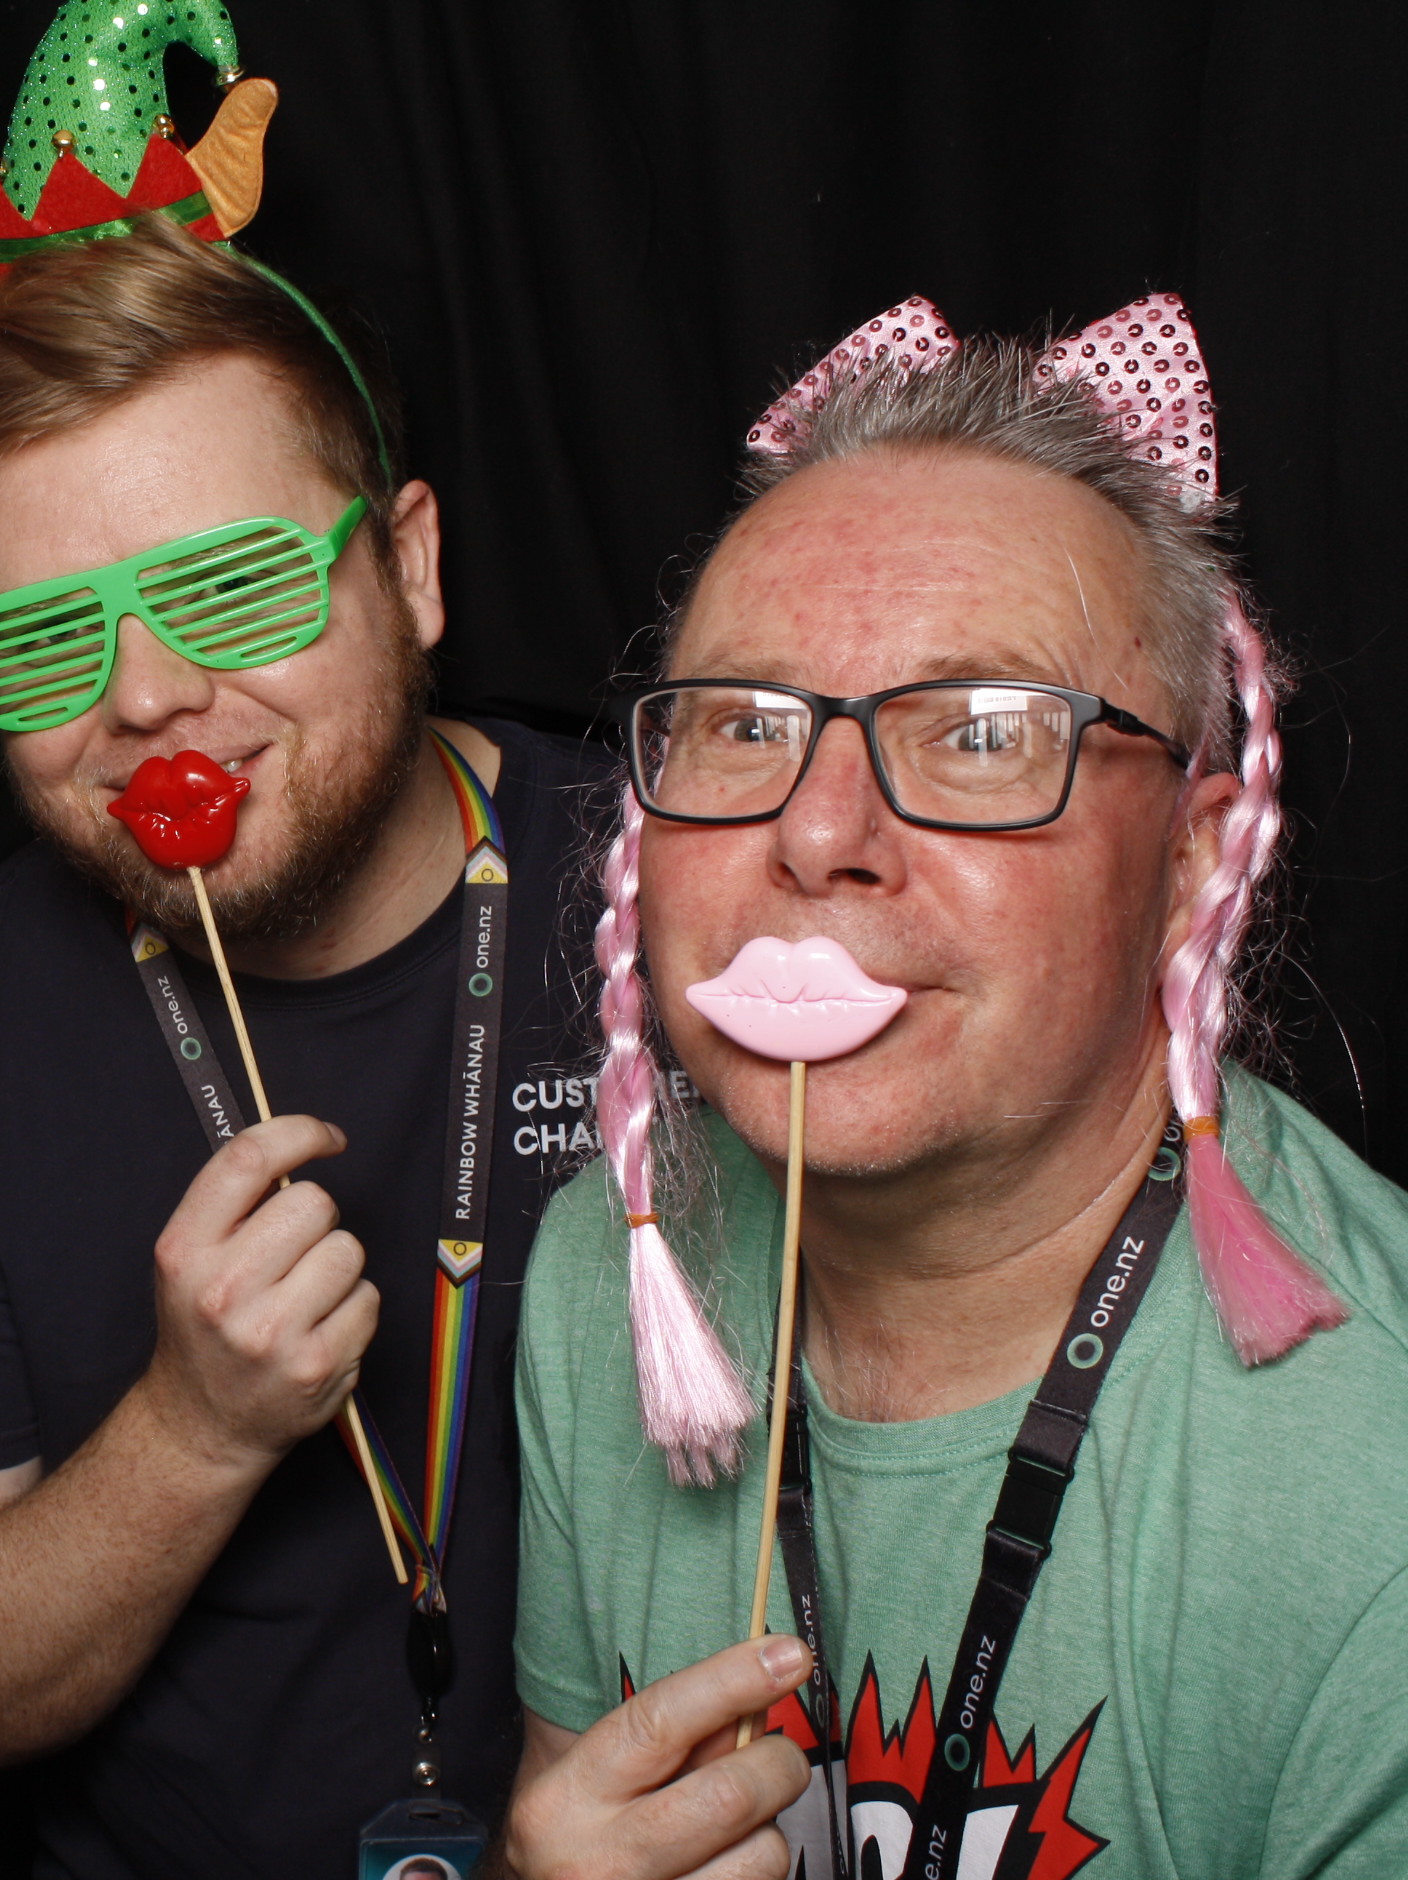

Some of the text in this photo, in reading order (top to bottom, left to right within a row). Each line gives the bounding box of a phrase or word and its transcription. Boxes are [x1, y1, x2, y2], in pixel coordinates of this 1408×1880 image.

[476, 905, 492, 968] one.nz
[158, 975, 188, 1034] one.nz
[201, 1084, 235, 1145] ĀNAU
[455, 1024, 486, 1220] RAINBOW WHĀNAU
[512, 1071, 700, 1112] CUSTE
[1090, 1236, 1144, 1328] one.nz
[960, 1635, 996, 1729] one.nz
[924, 1824, 947, 1880] e.nz
